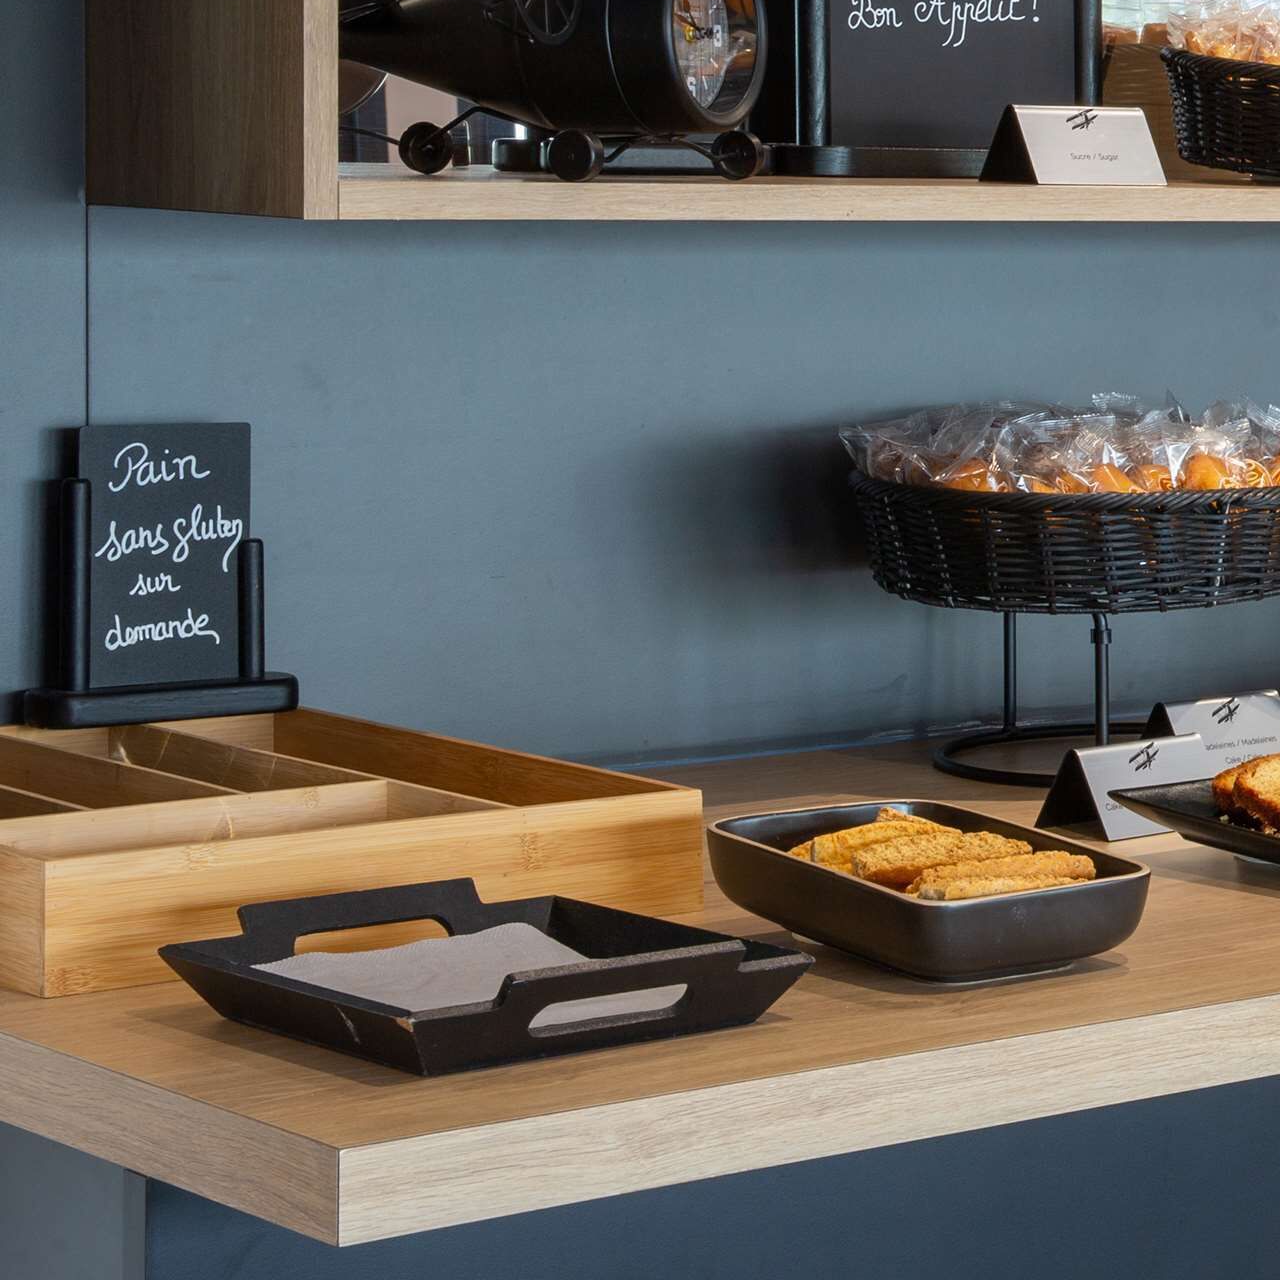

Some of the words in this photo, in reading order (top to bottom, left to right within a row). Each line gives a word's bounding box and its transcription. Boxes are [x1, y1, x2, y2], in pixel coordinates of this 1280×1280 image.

[108, 442, 211, 493] Pain
[94, 520, 170, 562] sans
[172, 503, 243, 573] gluten
[128, 572, 182, 596] sur
[104, 607, 221, 651] demande
